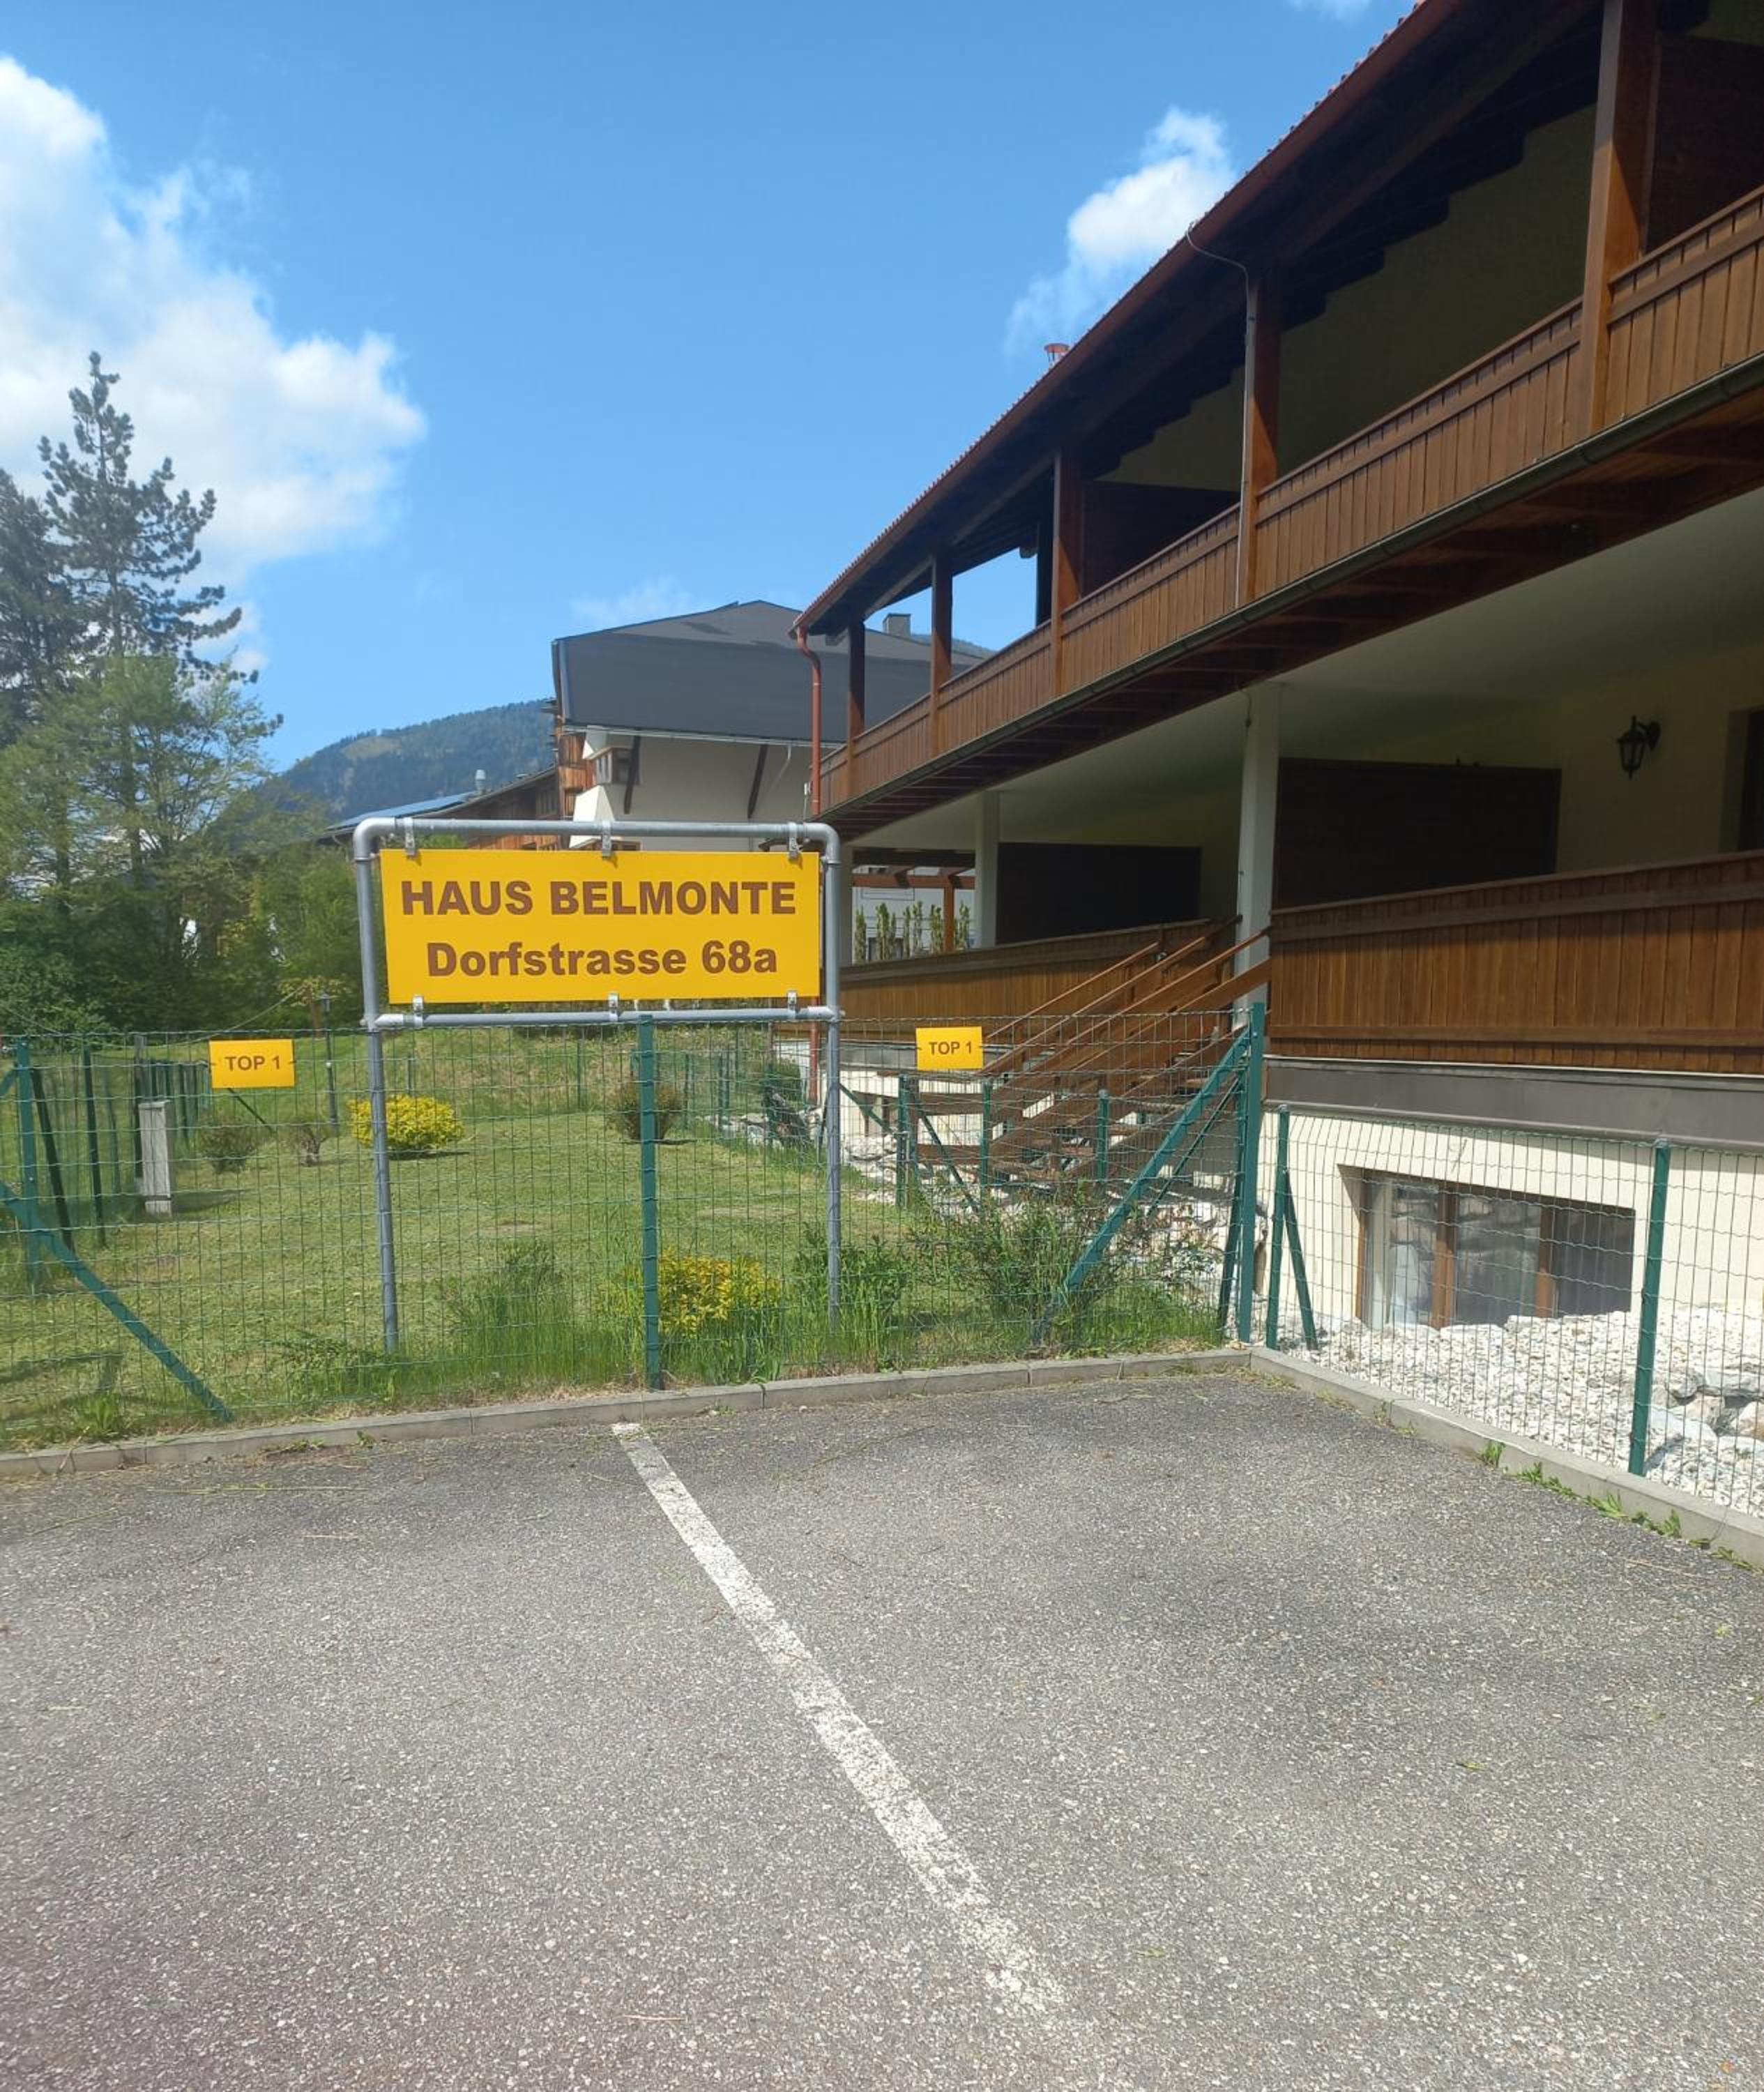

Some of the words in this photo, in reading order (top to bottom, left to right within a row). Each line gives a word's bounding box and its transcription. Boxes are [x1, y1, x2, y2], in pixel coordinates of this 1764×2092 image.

[400, 881, 533, 916] HAUS
[550, 881, 796, 916] BELMONTE
[427, 941, 687, 976] Dorfstrasse
[701, 940, 777, 973] 68a
[928, 1041, 960, 1055] TOP
[965, 1040, 972, 1054] 1
[225, 1055, 266, 1071] TOP
[271, 1055, 280, 1070] 1
